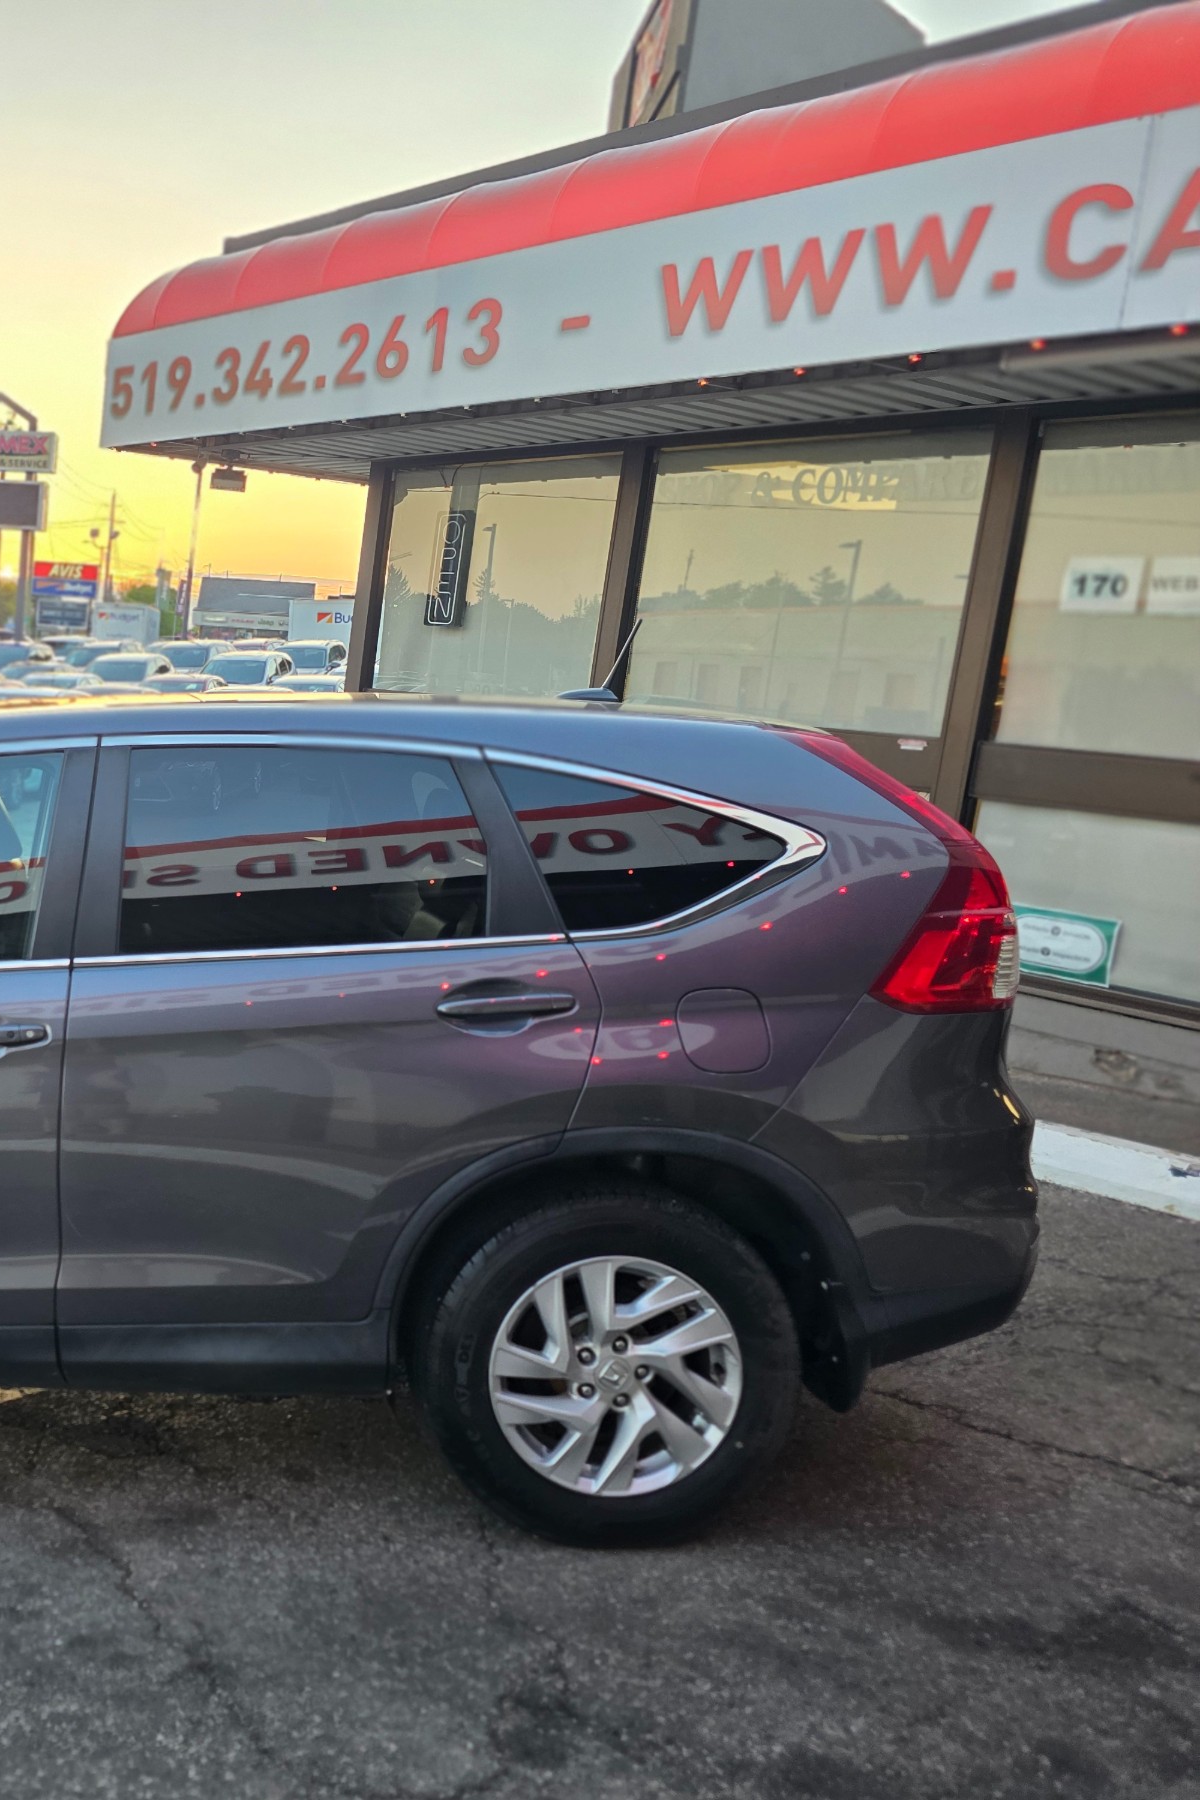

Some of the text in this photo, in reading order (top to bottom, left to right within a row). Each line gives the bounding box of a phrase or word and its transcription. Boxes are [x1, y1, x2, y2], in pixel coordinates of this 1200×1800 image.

[110, 298, 503, 418] 519.342.2613
[8, 458, 49, 469] SERVICE
[48, 564, 83, 579] AVIS
[434, 520, 461, 619] OPEN
[1072, 572, 1129, 598] 170
[334, 612, 353, 624] Bu
